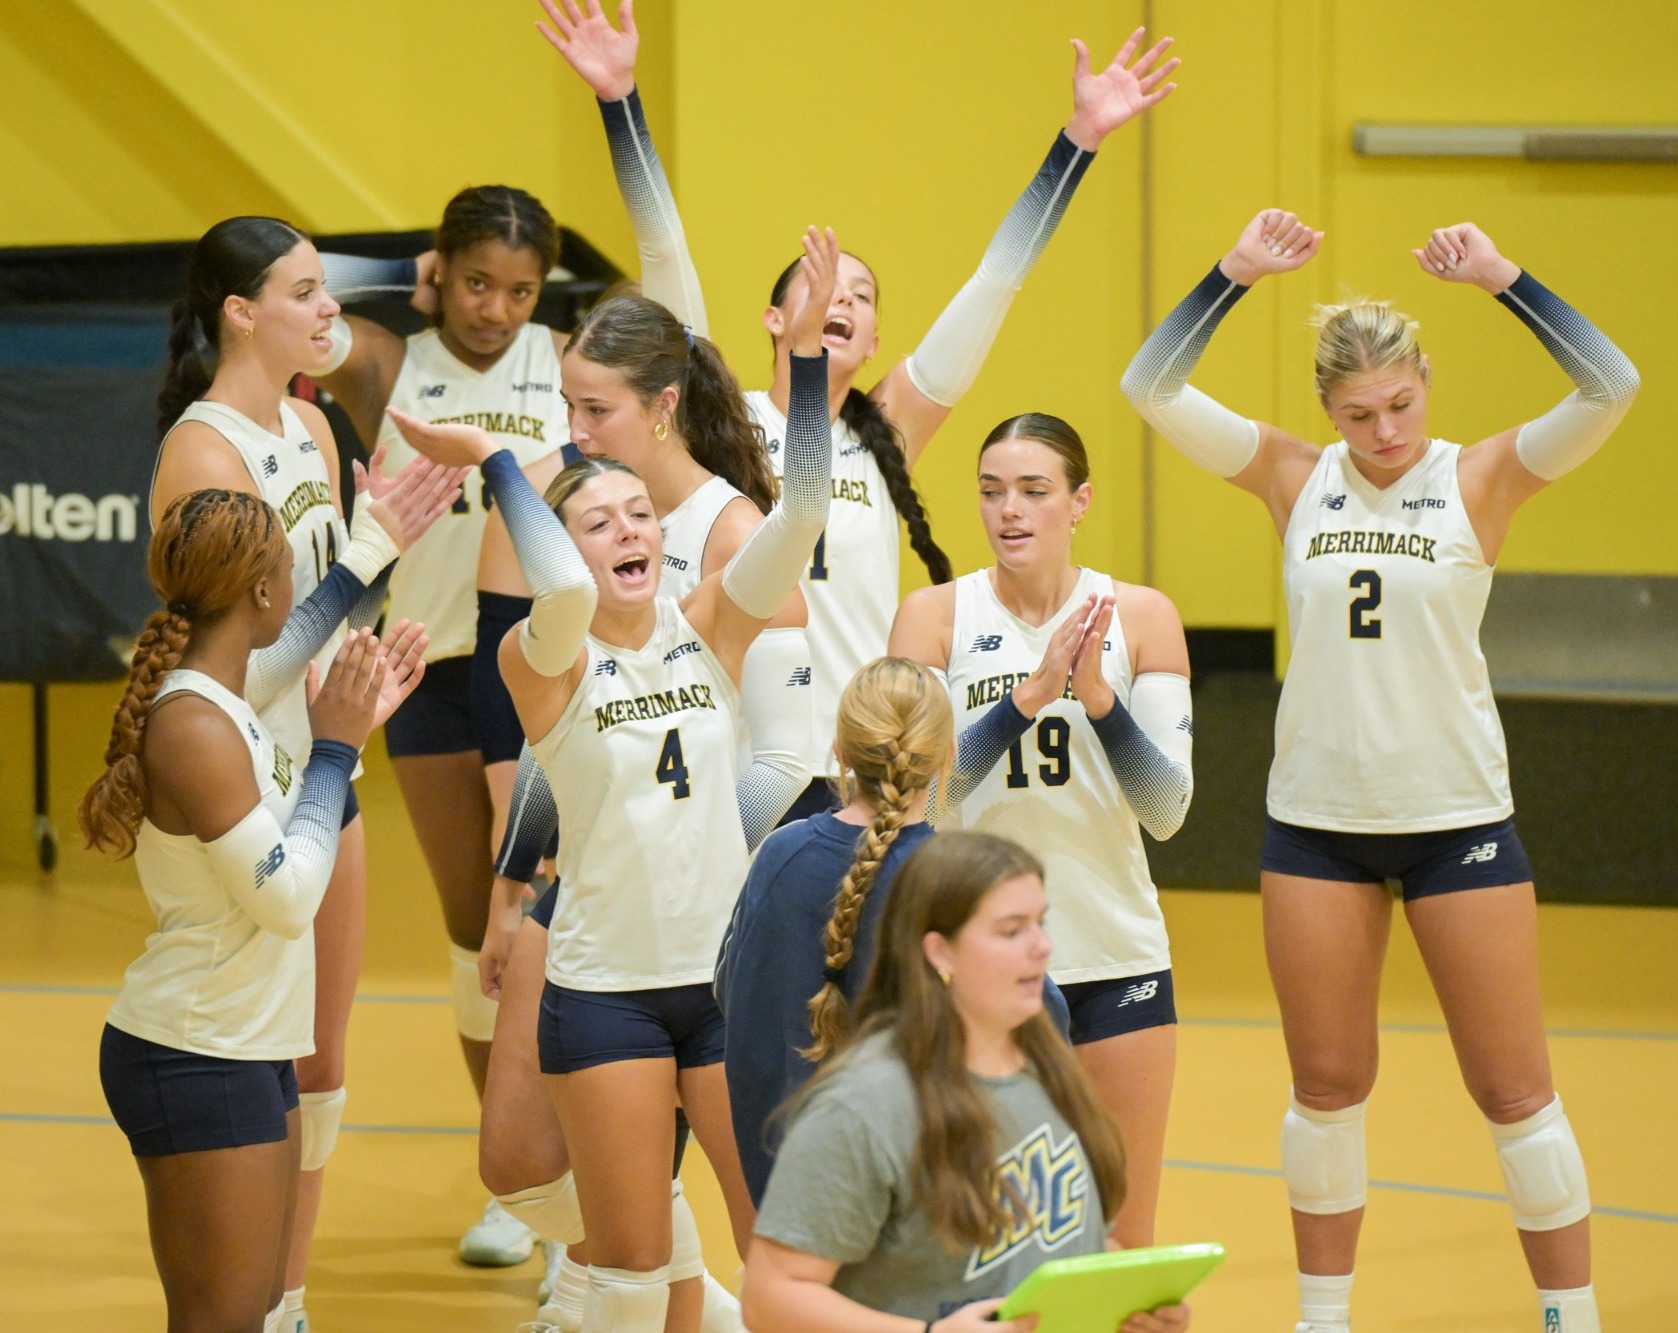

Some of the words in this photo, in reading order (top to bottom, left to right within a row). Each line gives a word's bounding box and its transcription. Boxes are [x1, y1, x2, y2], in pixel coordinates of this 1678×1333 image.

[1402, 498, 1446, 510] METRO
[1305, 530, 1437, 563] MERRIMACK
[1348, 568, 1382, 640] 2
[663, 641, 702, 665] METRO
[595, 684, 717, 734] MERRIMACK
[655, 727, 691, 801] 4
[1006, 715, 1071, 789] 19
